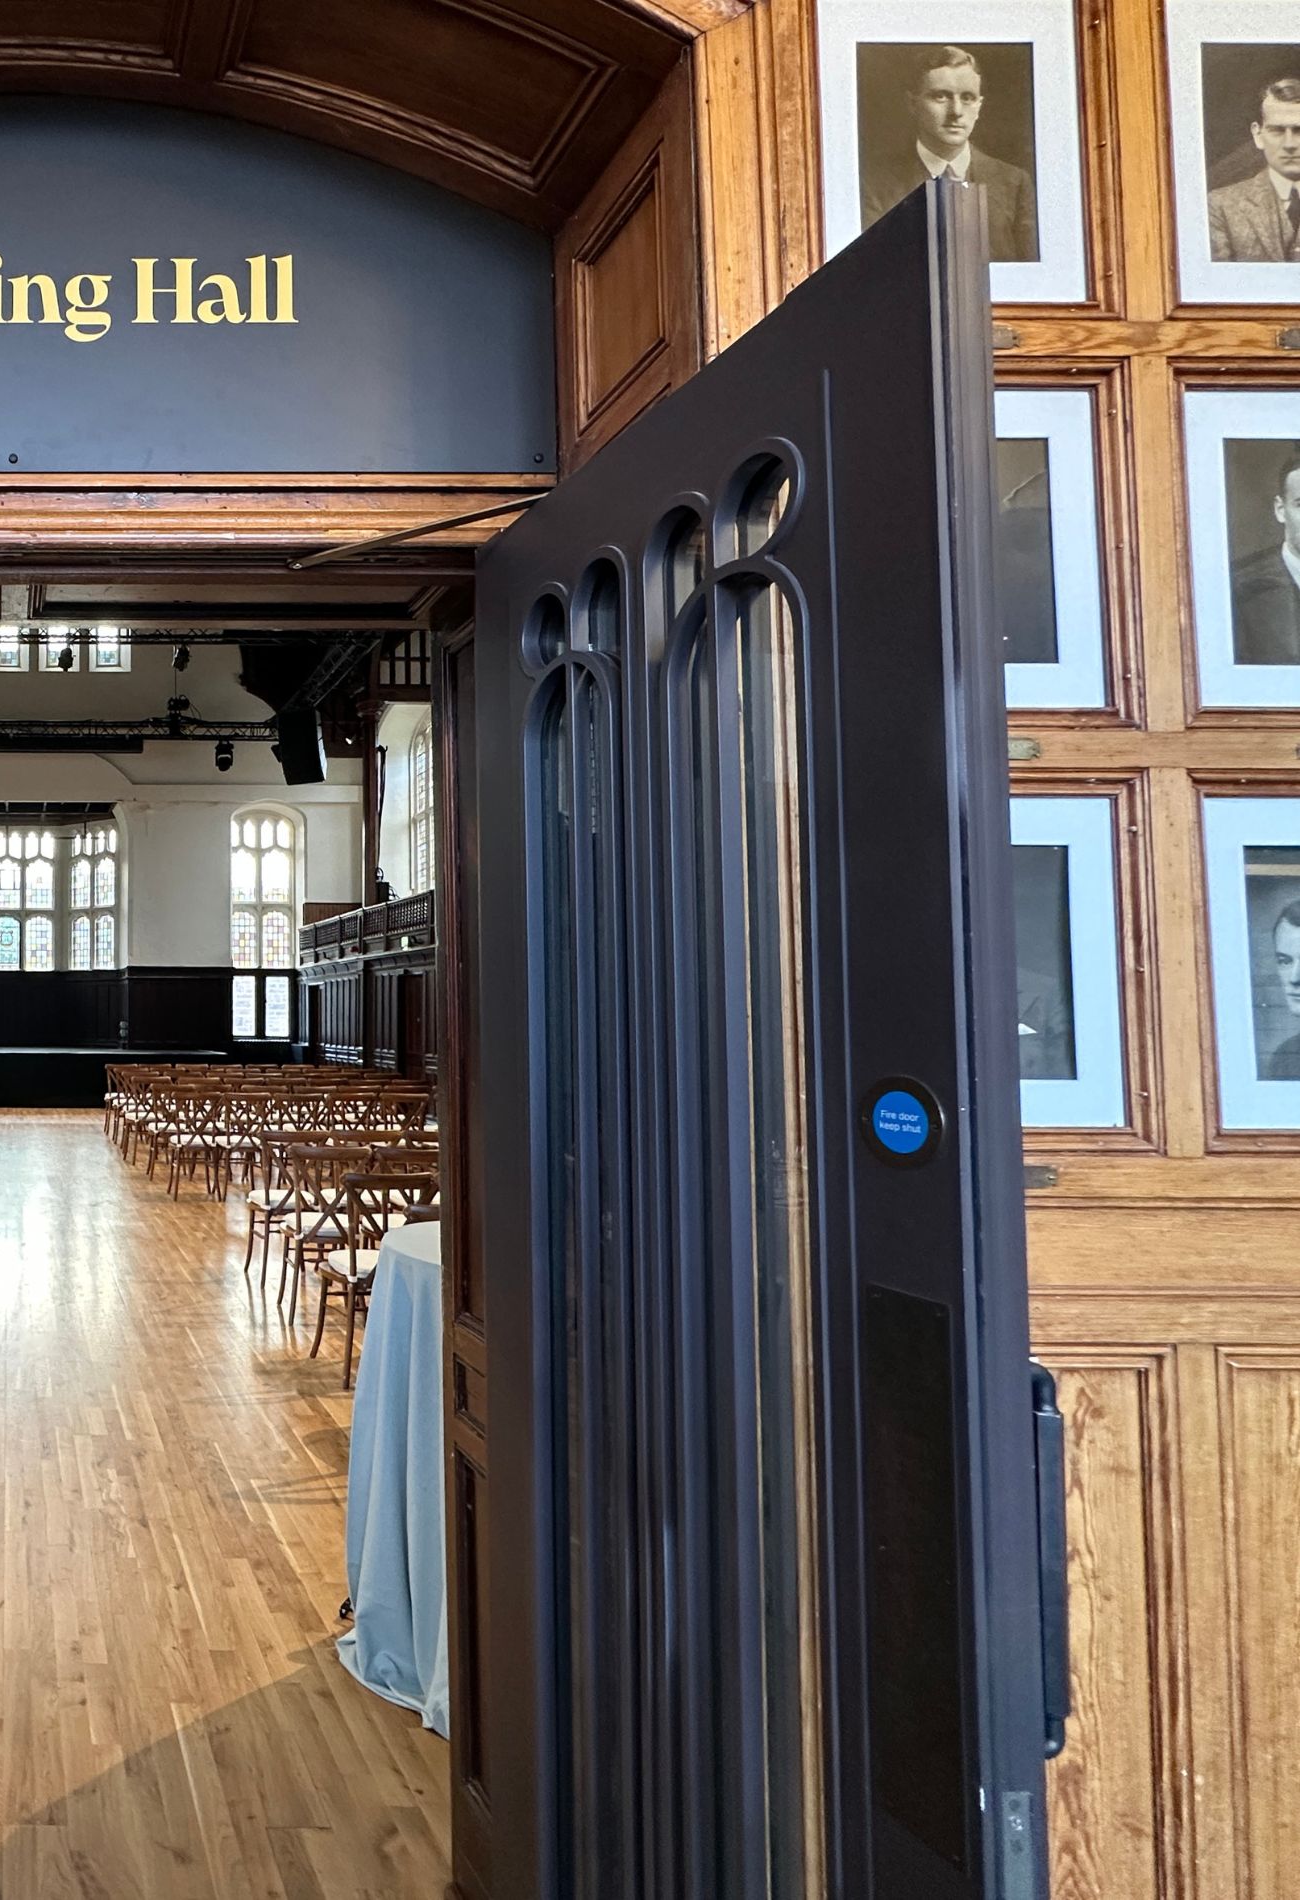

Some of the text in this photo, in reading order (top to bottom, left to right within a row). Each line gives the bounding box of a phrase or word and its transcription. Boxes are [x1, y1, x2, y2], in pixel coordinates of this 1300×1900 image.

[131, 254, 299, 324] Hall
[880, 1109, 920, 1122] Fire door
[879, 1120, 922, 1133] keep shut
